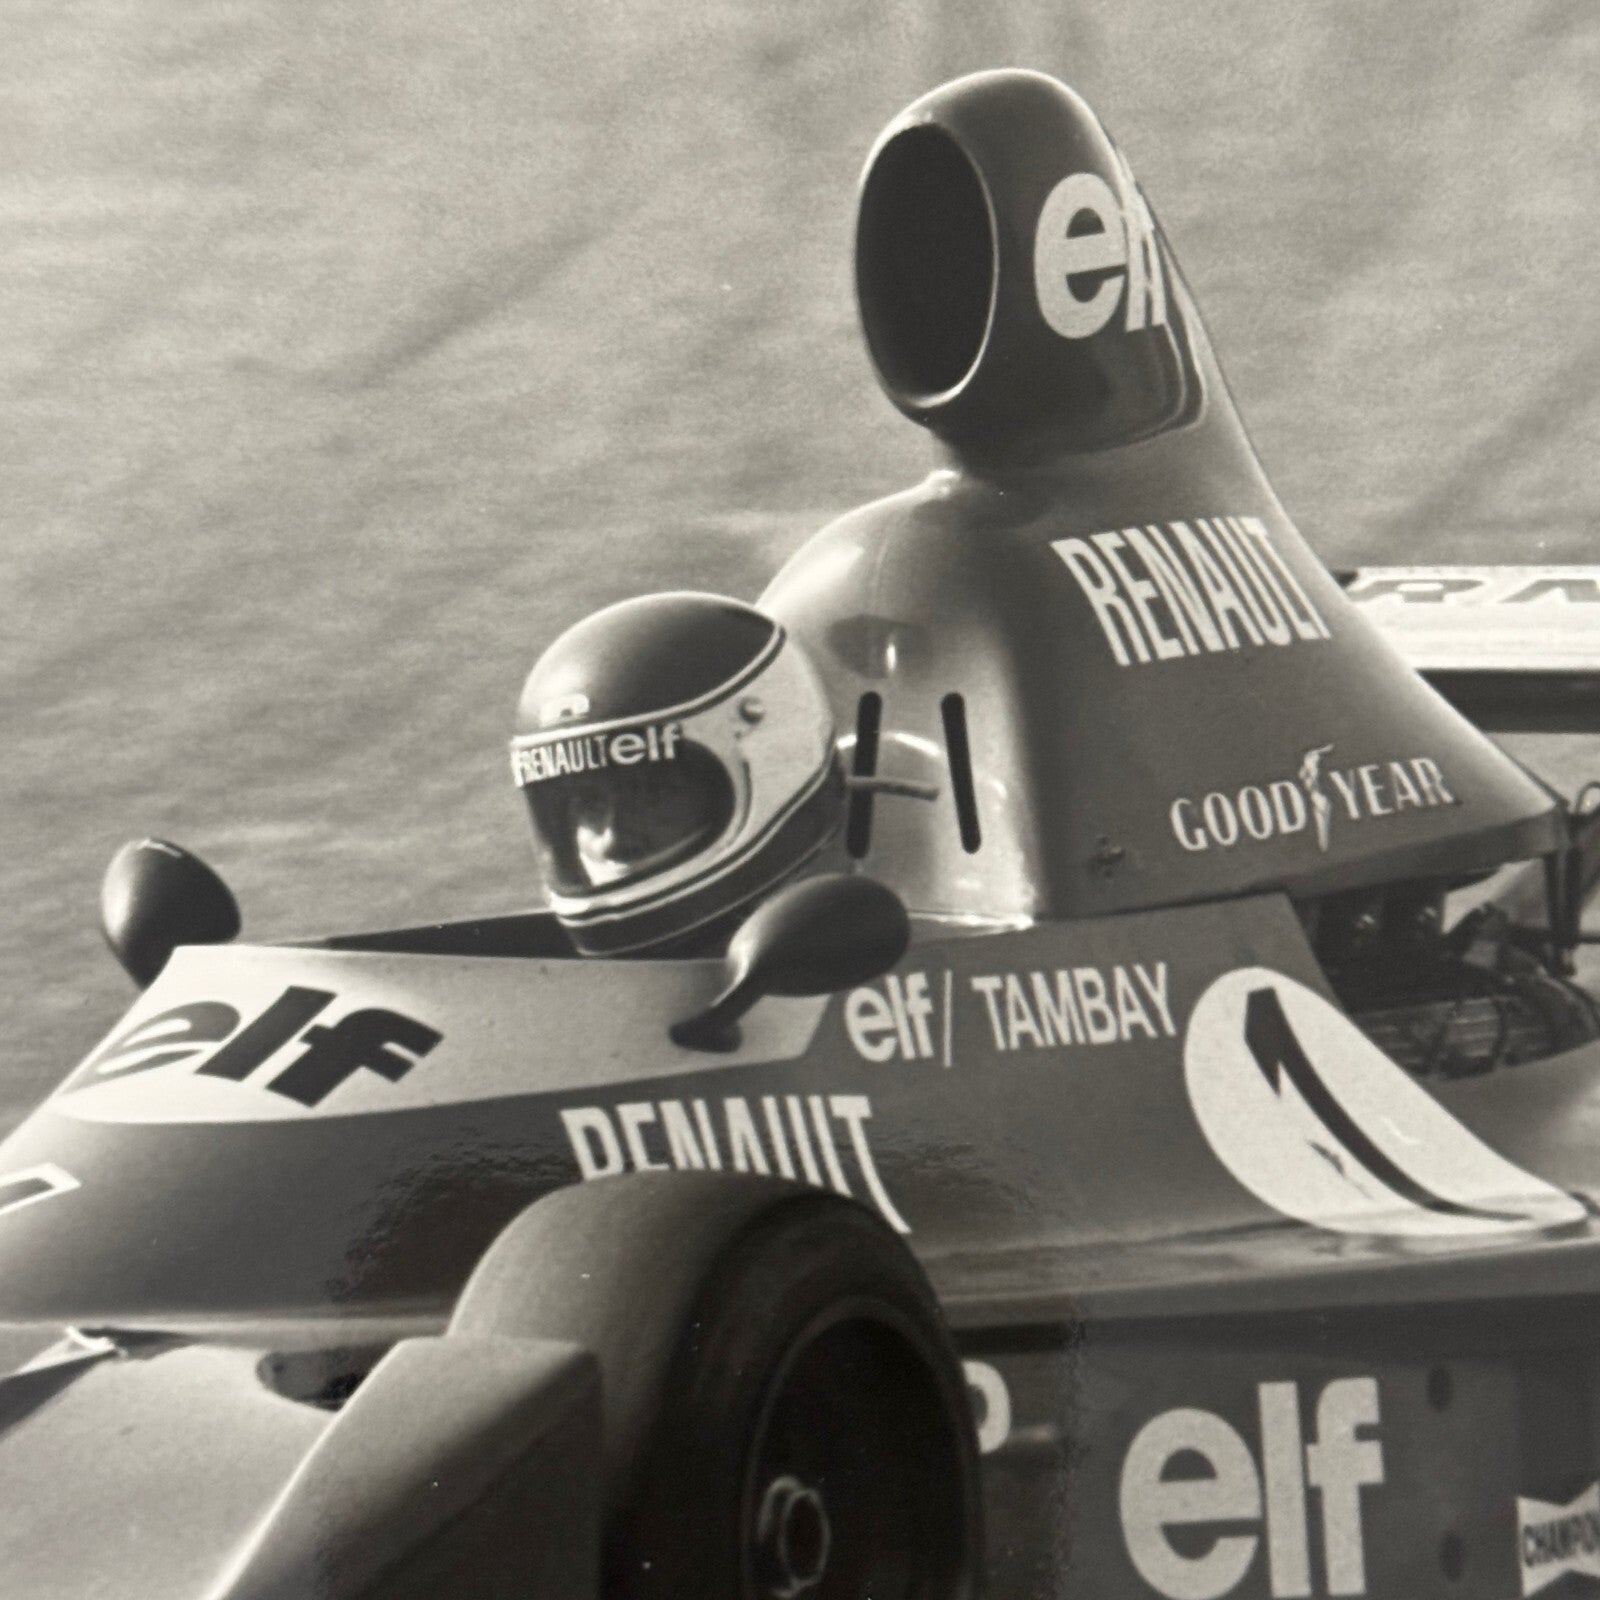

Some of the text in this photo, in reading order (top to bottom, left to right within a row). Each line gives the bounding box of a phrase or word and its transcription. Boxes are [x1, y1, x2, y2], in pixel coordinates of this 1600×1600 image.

[1050, 516, 1332, 666] RENAULT
[610, 723, 683, 764] elf
[58, 985, 445, 1108] elf
[971, 961, 1177, 1051] TAMBAY
[1243, 986, 1532, 1222] 1
[1119, 1376, 1385, 1600] elf
